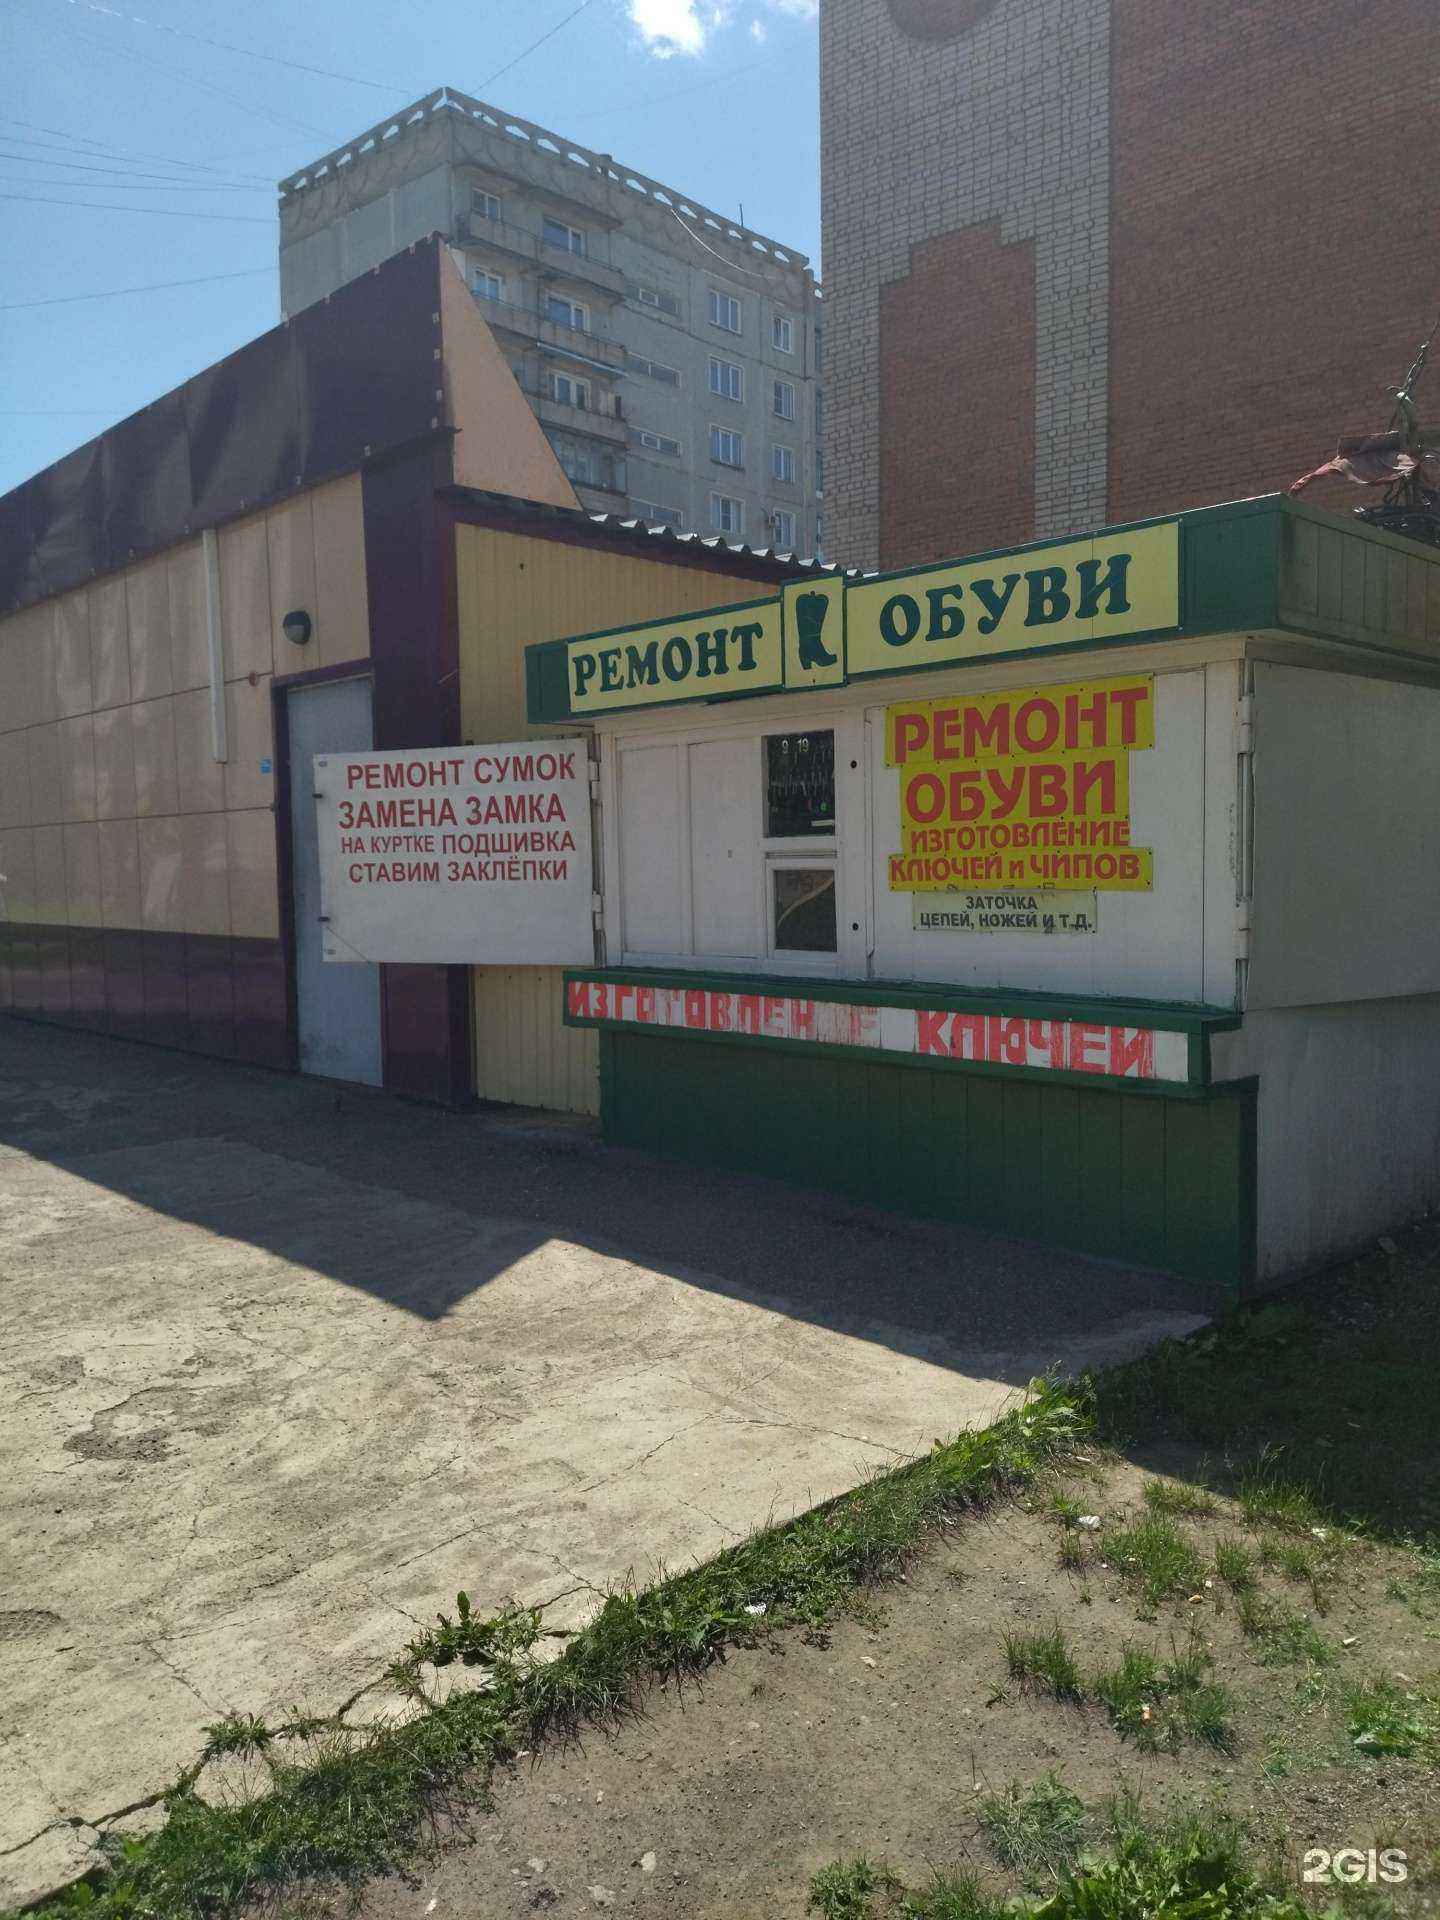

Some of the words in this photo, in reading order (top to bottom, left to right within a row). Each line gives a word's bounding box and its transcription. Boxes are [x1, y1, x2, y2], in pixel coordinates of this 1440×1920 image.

[573, 622, 764, 697] РЕМОНТ
[879, 553, 1133, 646] ОБУВИ
[894, 686, 1149, 763] РЕМОНТ
[347, 759, 465, 789] РЕМОНТ
[474, 752, 576, 784] СУМОК
[906, 760, 1116, 823] ОБУВИ
[338, 799, 458, 829] ЗАМЕНА
[466, 793, 566, 826] ЗАМКА
[341, 837, 366, 854] НА
[371, 835, 435, 854] КУРТКЕ
[442, 830, 577, 857] ПОДШИВКА
[911, 821, 1130, 854] ИЗГОТОВЛЕНИЕ
[349, 862, 440, 883] СТАВИМ
[447, 855, 568, 881] ЗАКЛЁПКИ
[891, 852, 1003, 882] КЛЮЧЕЙ
[1030, 853, 1140, 880] ЧИПОВ
[966, 896, 1038, 910] ЗАТОЧКА
[920, 910, 975, 930] ЦЕПЕЙ,
[979, 911, 1038, 928] НОЖЕЙ
